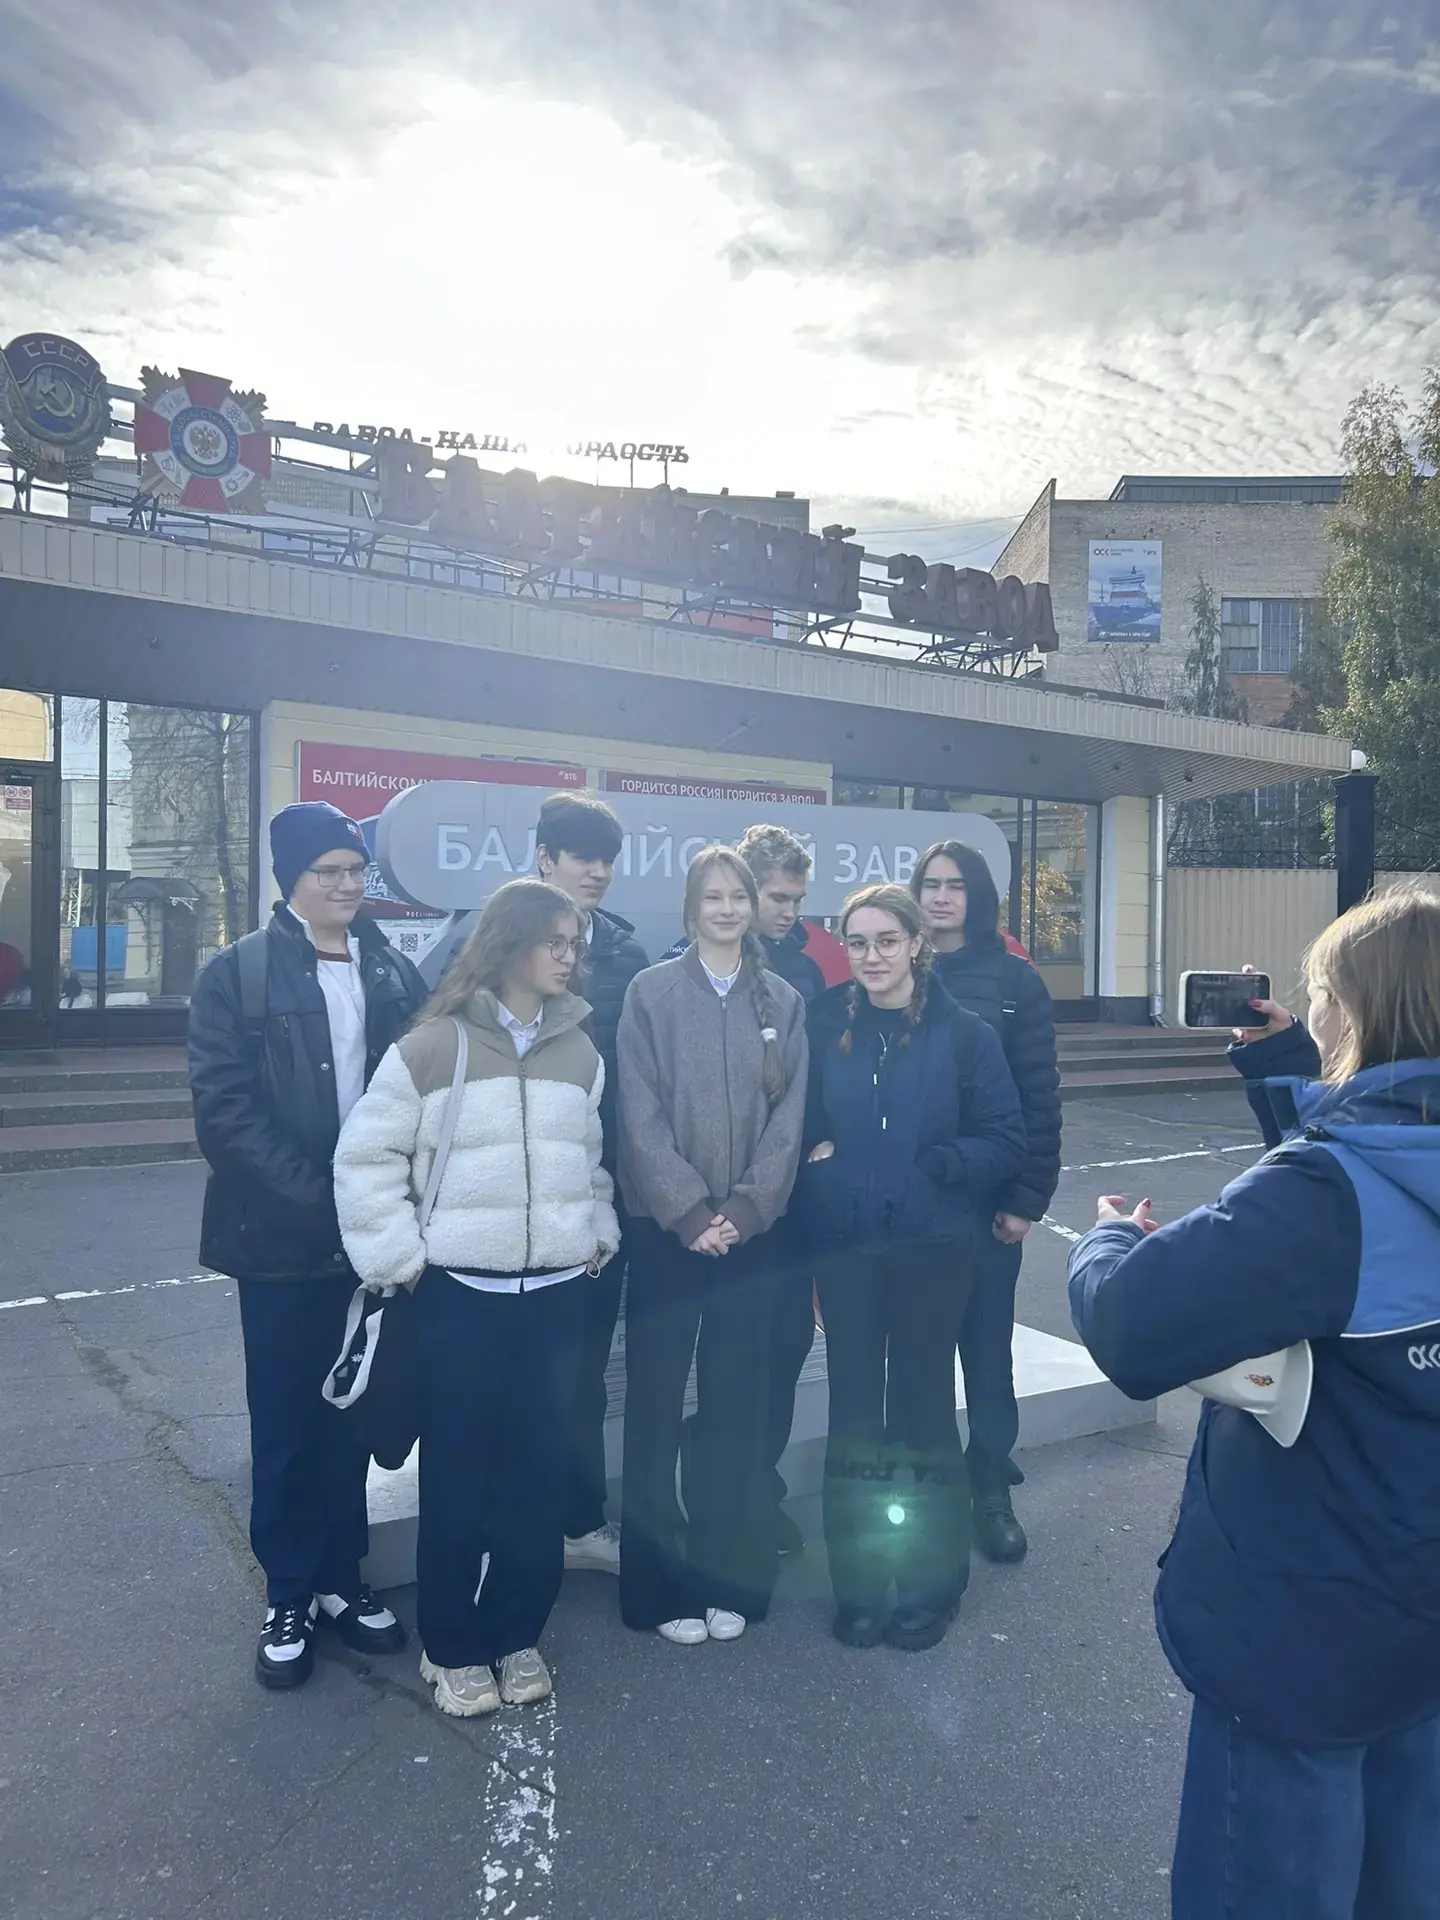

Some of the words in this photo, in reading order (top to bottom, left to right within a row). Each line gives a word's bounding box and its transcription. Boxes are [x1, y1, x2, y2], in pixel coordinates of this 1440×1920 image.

[22, 341, 89, 367] СССР
[435, 430, 527, 453] НАША
[549, 441, 690, 463] ОРДОСТЬ
[888, 553, 1060, 653] ЗАВОД
[621, 779, 677, 795] ГОРДИТСЯ
[680, 785, 724, 799] РОССИЯ!
[727, 789, 777, 803] ГОРДИТСЯ
